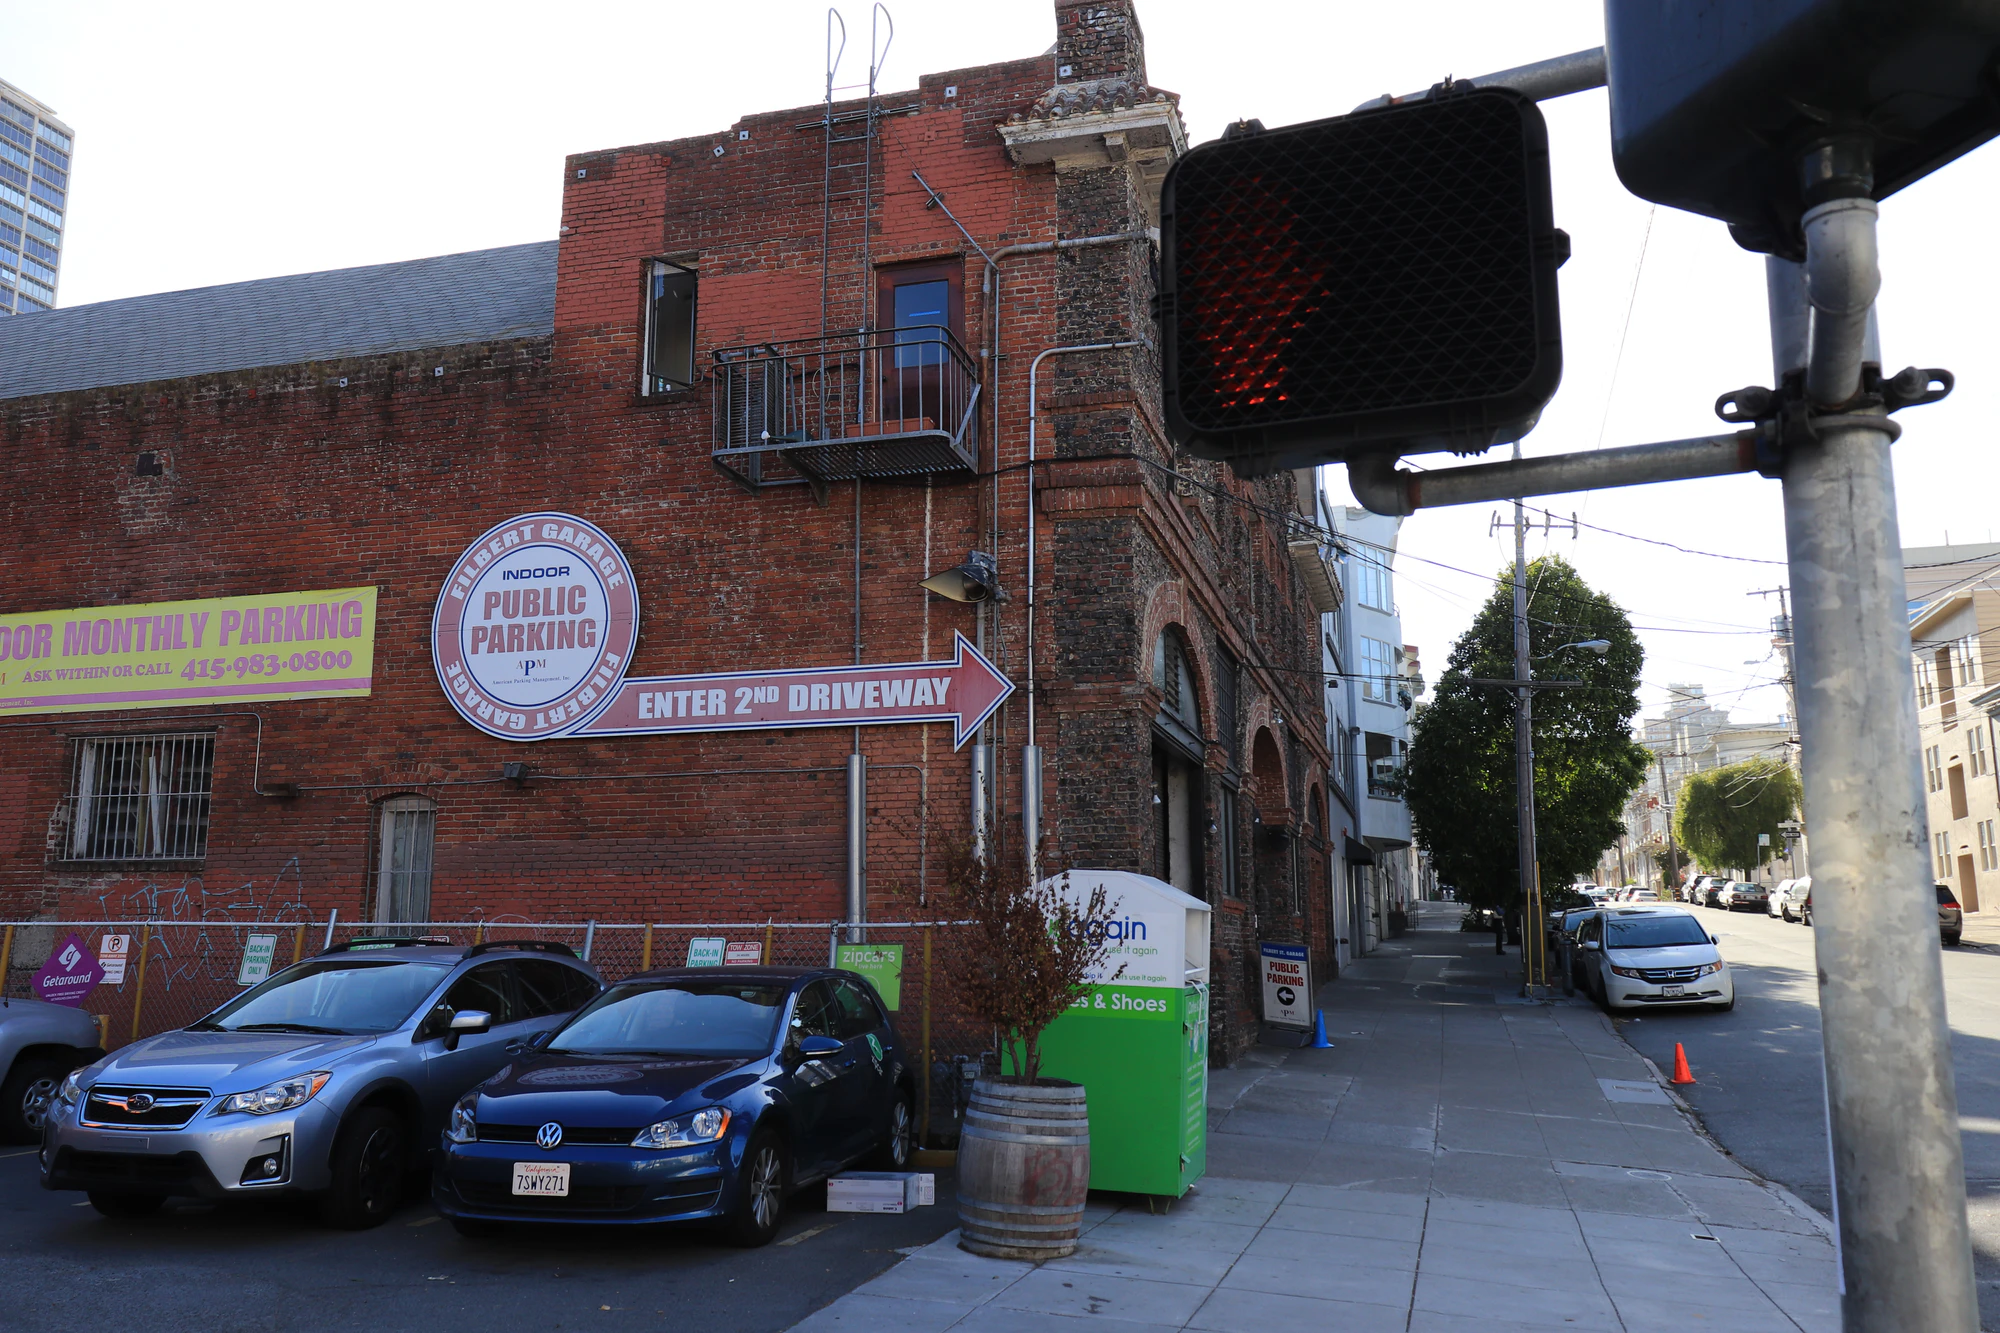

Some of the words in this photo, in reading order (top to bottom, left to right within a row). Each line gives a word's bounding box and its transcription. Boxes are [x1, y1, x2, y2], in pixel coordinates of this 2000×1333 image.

[450, 524, 535, 600] FILBERT
[541, 523, 625, 590] GARAGE
[503, 566, 570, 581] INDOOR
[483, 584, 587, 620] PUBLIC
[62, 612, 210, 657] MONTHLY
[219, 600, 363, 647] PARKING
[470, 618, 597, 655] PARKING
[22, 669, 52, 683] ASK
[55, 666, 111, 681] WITHIN
[112, 665, 133, 678] OR
[135, 662, 173, 677] CALL
[516, 658, 546, 676] APM
[445, 659, 528, 731] GARAGE
[532, 651, 621, 731] FILBERT
[638, 689, 727, 720] ENTER
[733, 685, 780, 715] 2ND
[788, 676, 952, 713] DRIVEWAY
[249, 945, 271, 953] BACK-IN
[693, 948, 719, 957] BACK-IN
[843, 948, 896, 966] zipcars
[1124, 946, 1130, 954] it
[1132, 947, 1158, 957] again
[246, 955, 269, 964] PARKING
[1269, 961, 1300, 974] PUBLIC
[43, 971, 92, 987] Getaround
[248, 966, 262, 974] ONLY
[1266, 973, 1304, 987] PARKING
[1094, 994, 1106, 1009] &
[1112, 993, 1167, 1012] Shoes
[517, 1175, 564, 1191] 7SWY271
